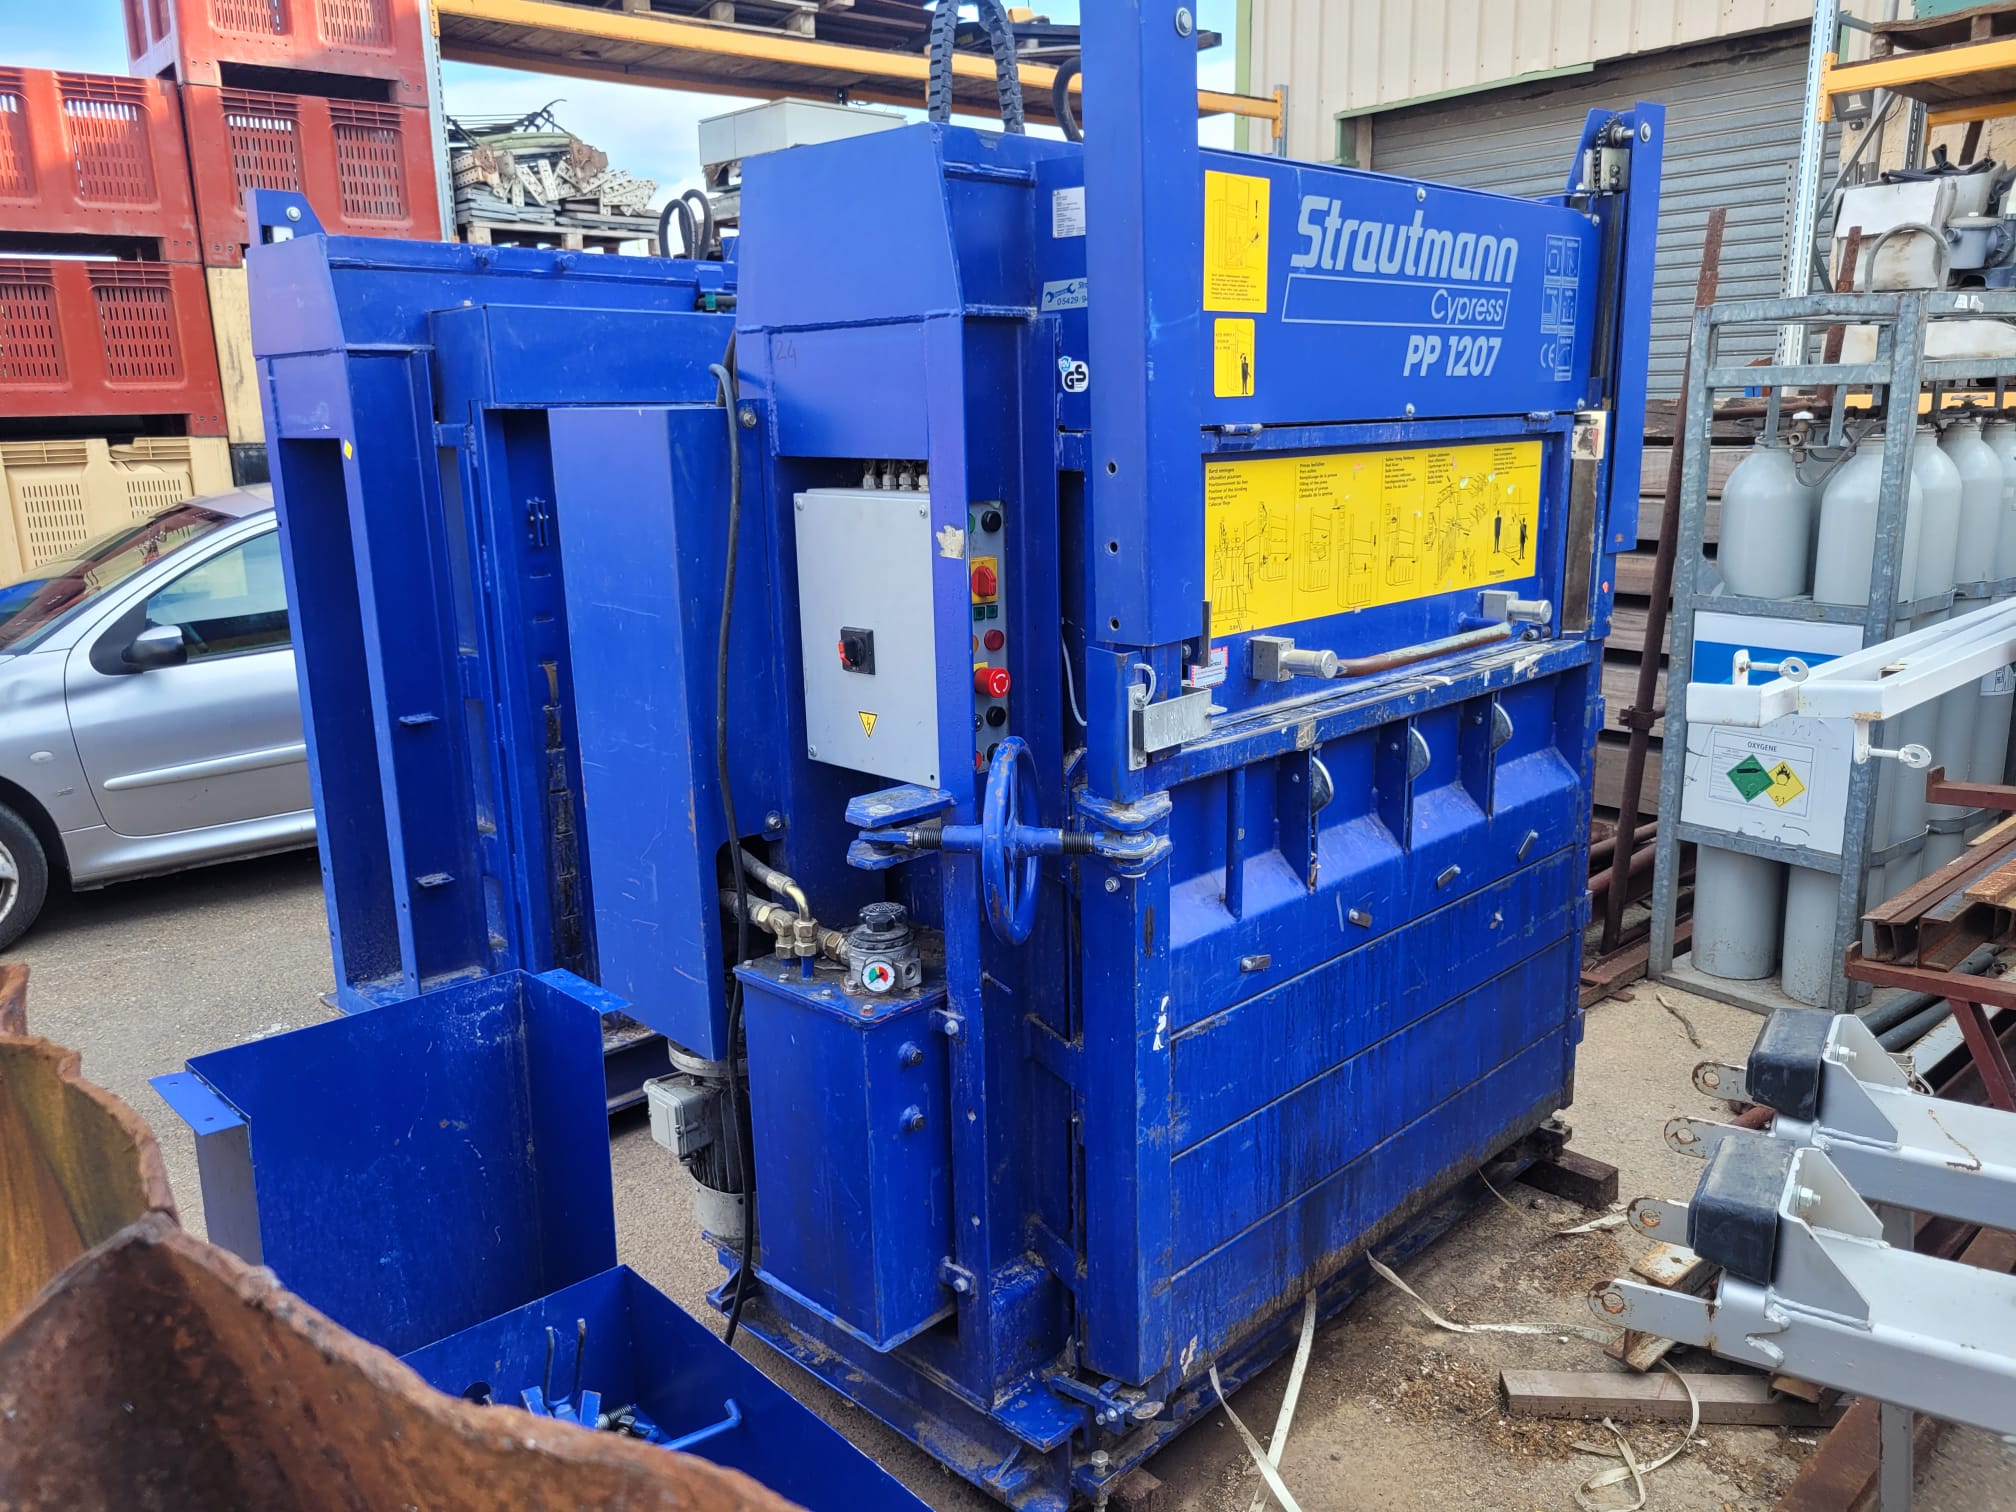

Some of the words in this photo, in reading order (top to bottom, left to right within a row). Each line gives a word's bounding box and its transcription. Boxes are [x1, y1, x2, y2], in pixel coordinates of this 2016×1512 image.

[1290, 195, 1519, 284] Strautmann
[1431, 288, 1504, 325] Cypress
[1403, 335, 1442, 377] PP
[1445, 335, 1503, 377] 1207
[1064, 364, 1087, 390] GS
[1747, 741, 1777, 753] OXYGENE
